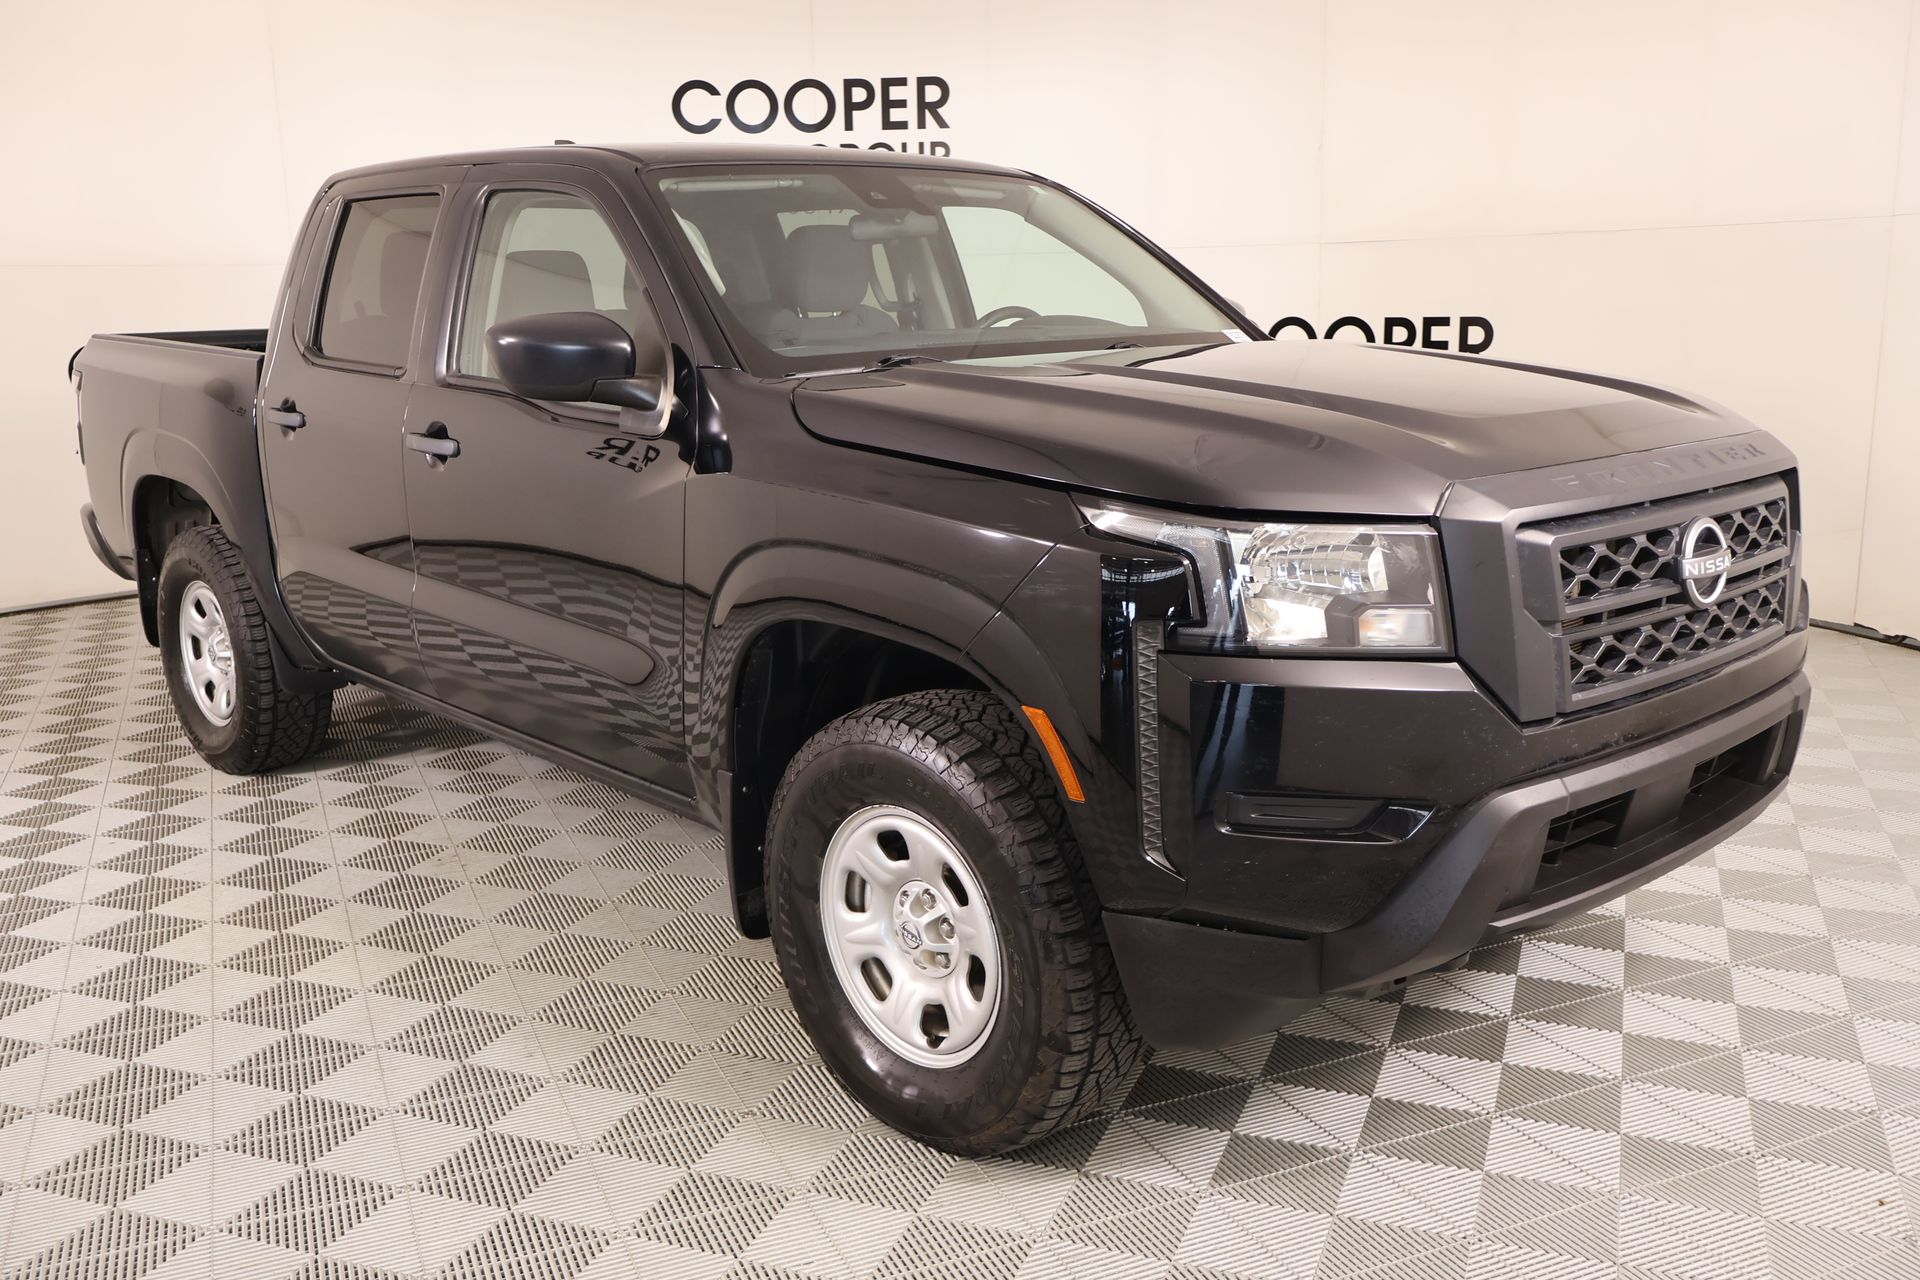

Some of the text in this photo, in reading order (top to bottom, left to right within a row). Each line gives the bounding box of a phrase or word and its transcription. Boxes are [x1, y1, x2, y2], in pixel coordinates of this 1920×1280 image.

[671, 76, 951, 135] COOPER
[1267, 316, 1494, 355] PER
[1685, 554, 1732, 577] NISSA
